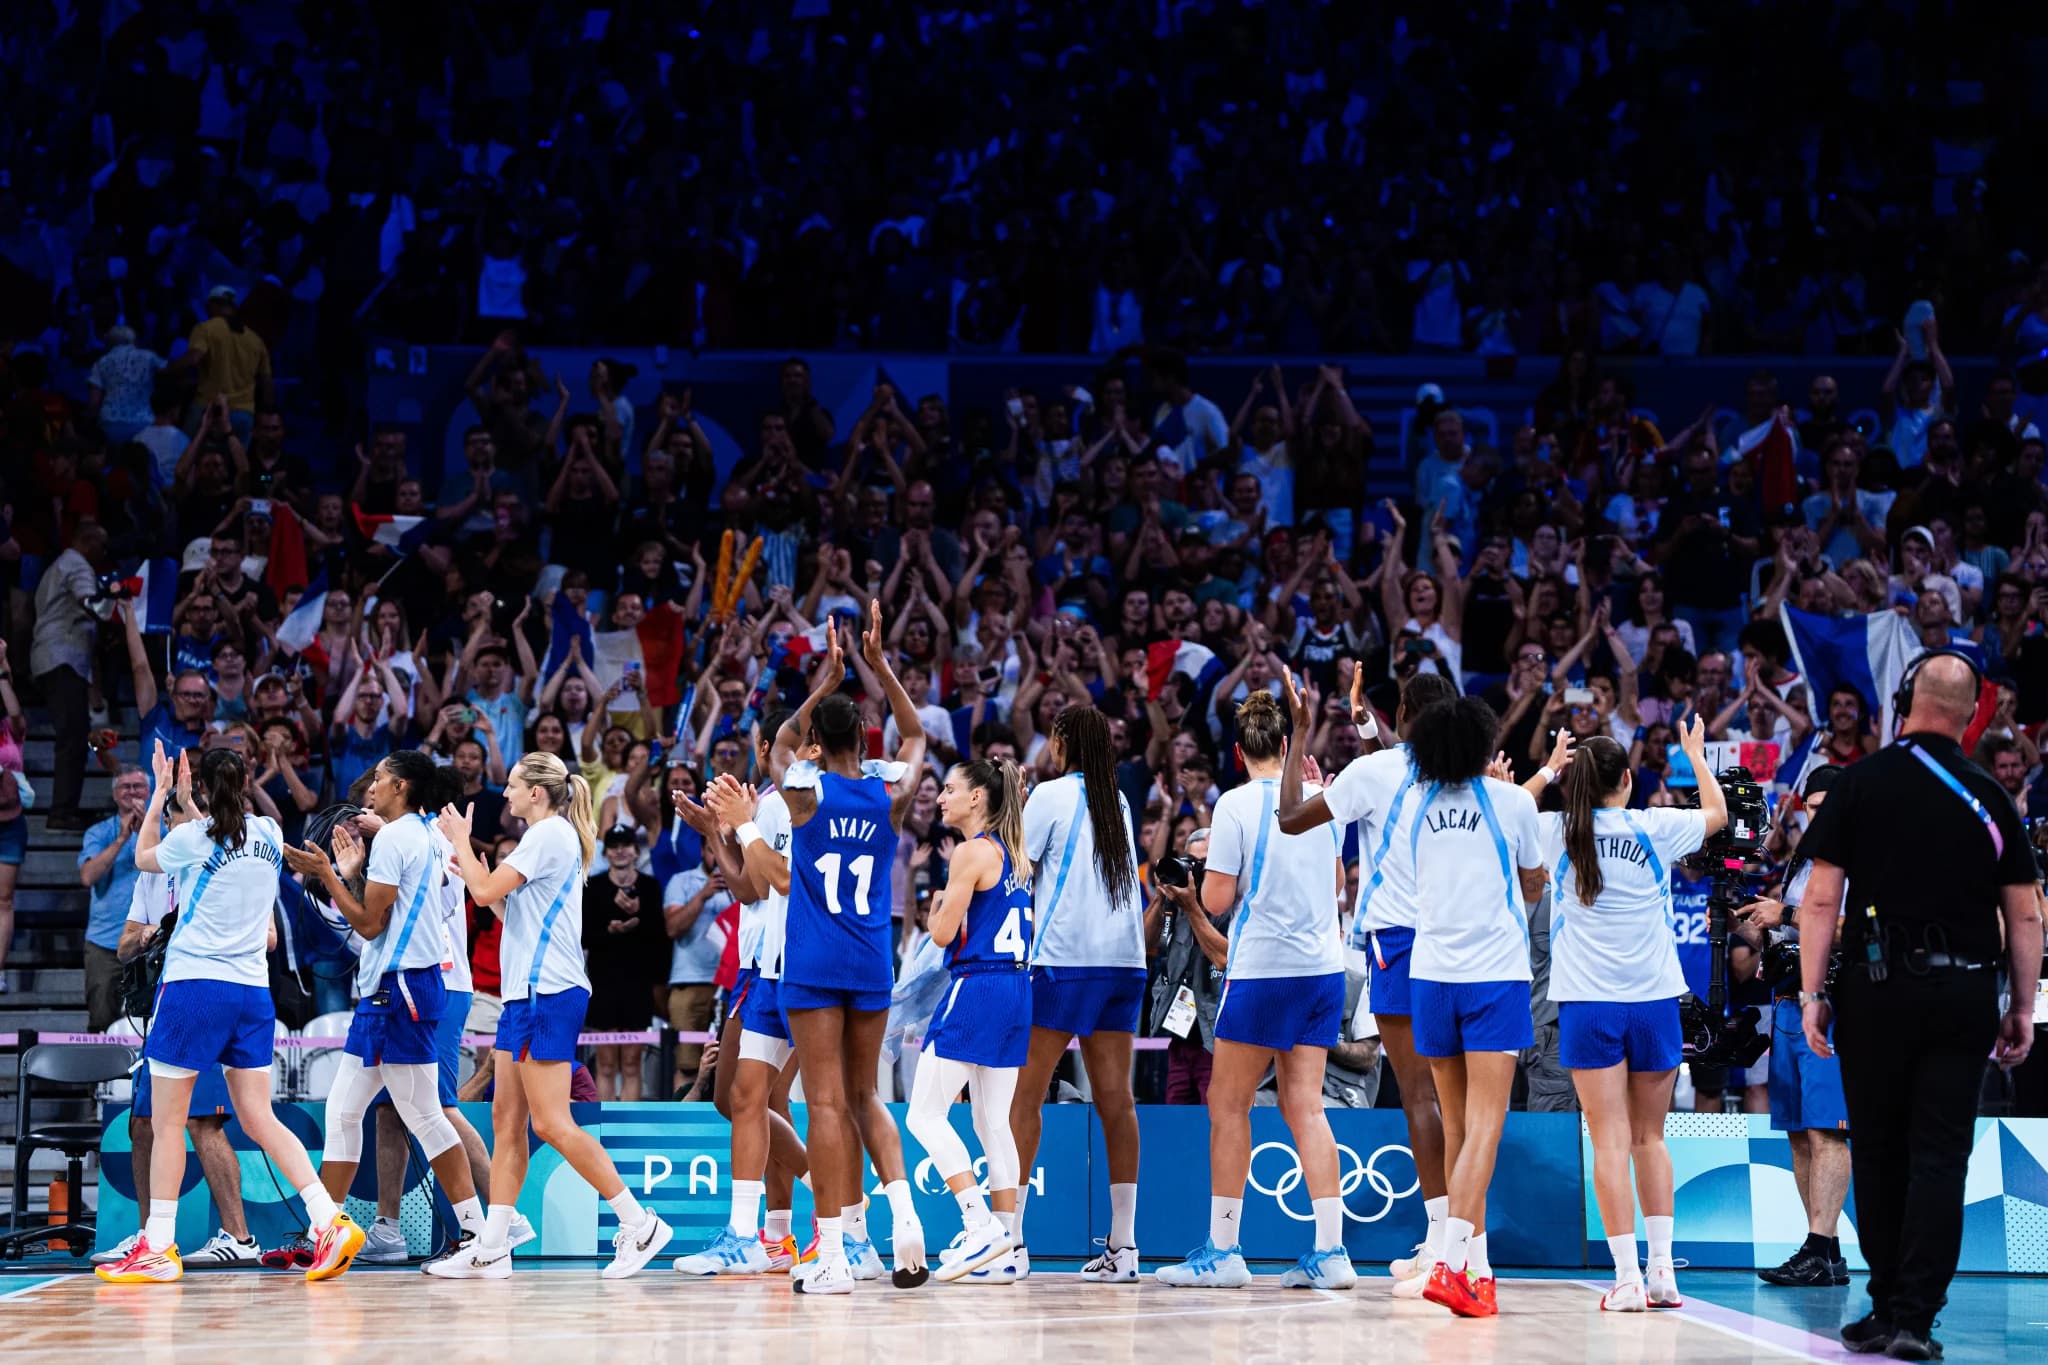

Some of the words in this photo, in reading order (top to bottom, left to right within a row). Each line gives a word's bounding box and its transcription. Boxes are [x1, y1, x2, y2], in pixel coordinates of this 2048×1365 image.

[829, 817, 877, 842] AYAYI
[1426, 808, 1482, 833] LACAN
[814, 852, 875, 915] 11
[1675, 912, 1708, 944] 32
[69, 1035, 98, 1043] PARIS
